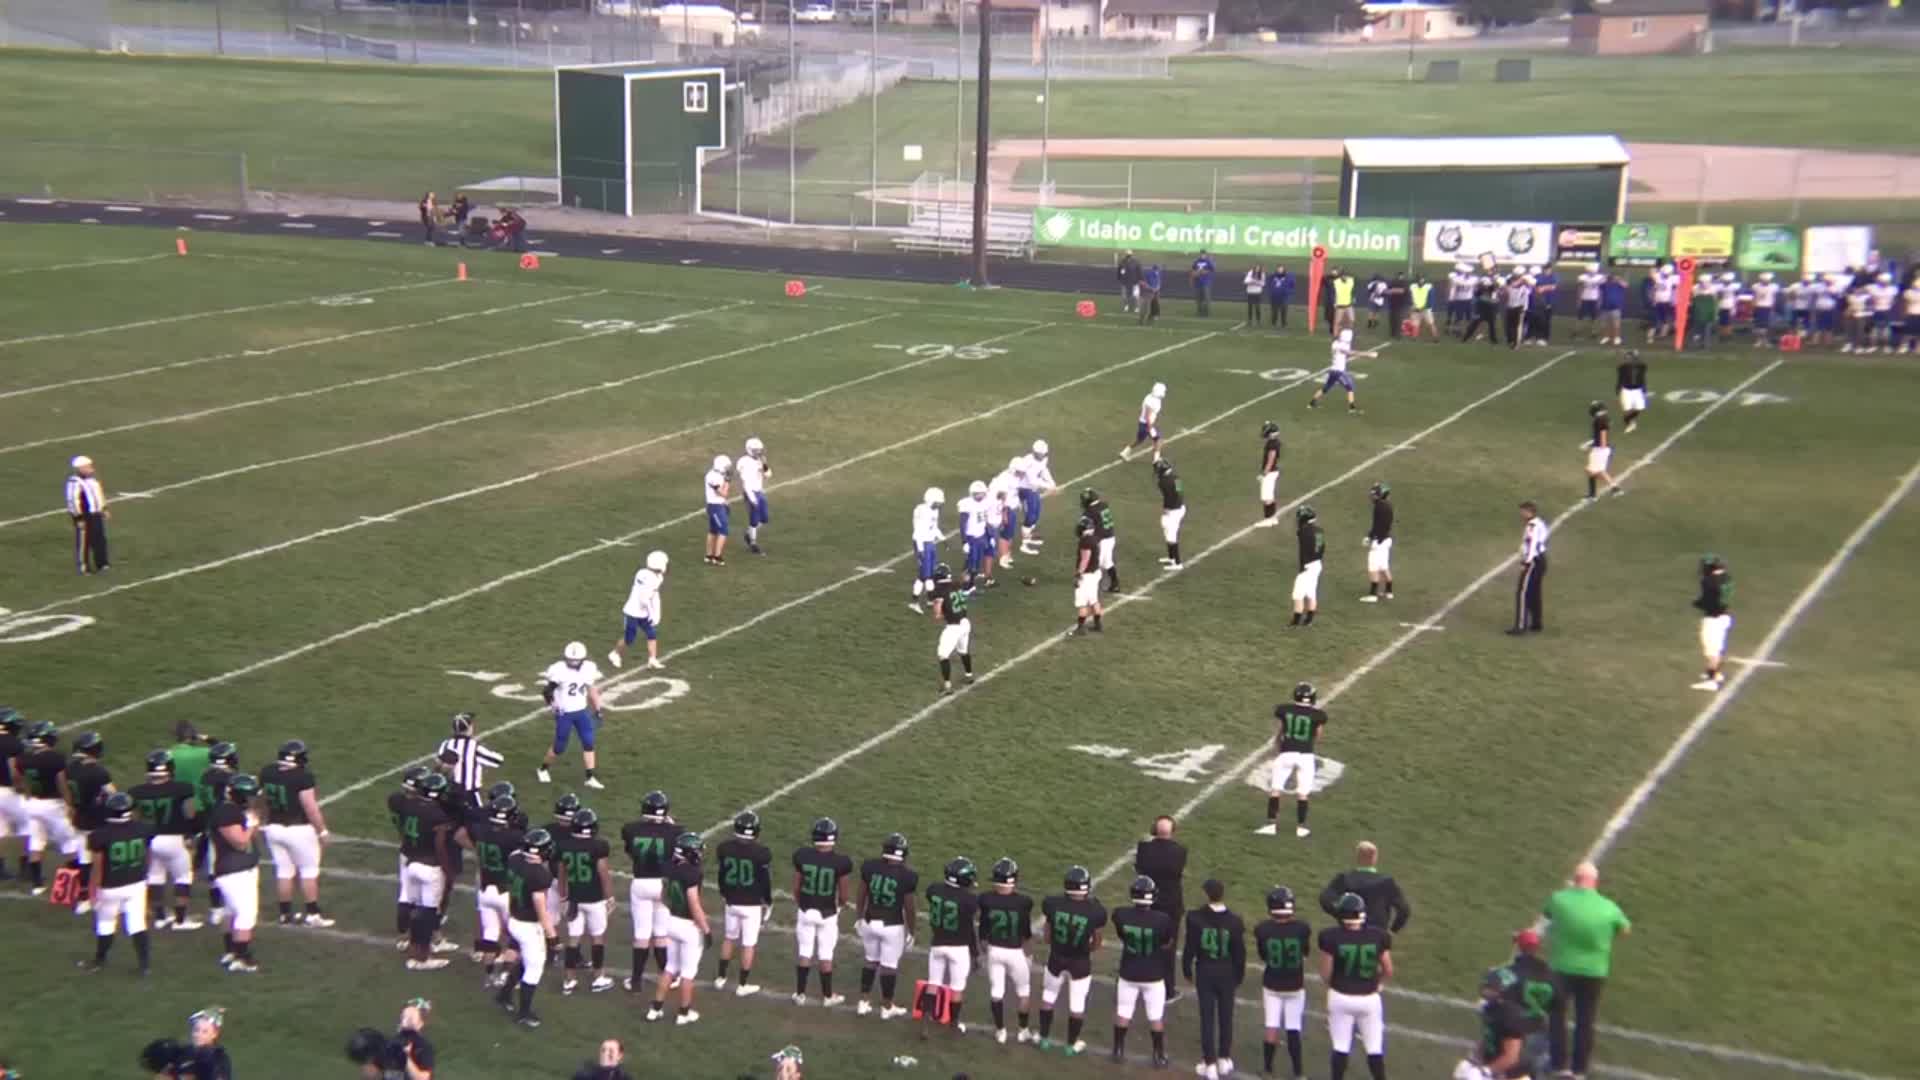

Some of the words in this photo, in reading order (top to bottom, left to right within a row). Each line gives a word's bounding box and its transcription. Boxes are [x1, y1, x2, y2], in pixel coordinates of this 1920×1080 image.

[1080, 218, 1142, 241] Idaho
[1150, 221, 1236, 245] Central
[1244, 224, 1319, 247] Credit
[1328, 228, 1401, 251] Union
[1285, 713, 1313, 742] 10
[110, 837, 147, 870] 90
[632, 836, 666, 866] 71
[724, 857, 755, 887] 20
[801, 863, 836, 897] 30
[869, 872, 899, 907] 45
[990, 908, 1020, 941] 21
[1053, 910, 1089, 945] 57
[1200, 926, 1231, 959] 41
